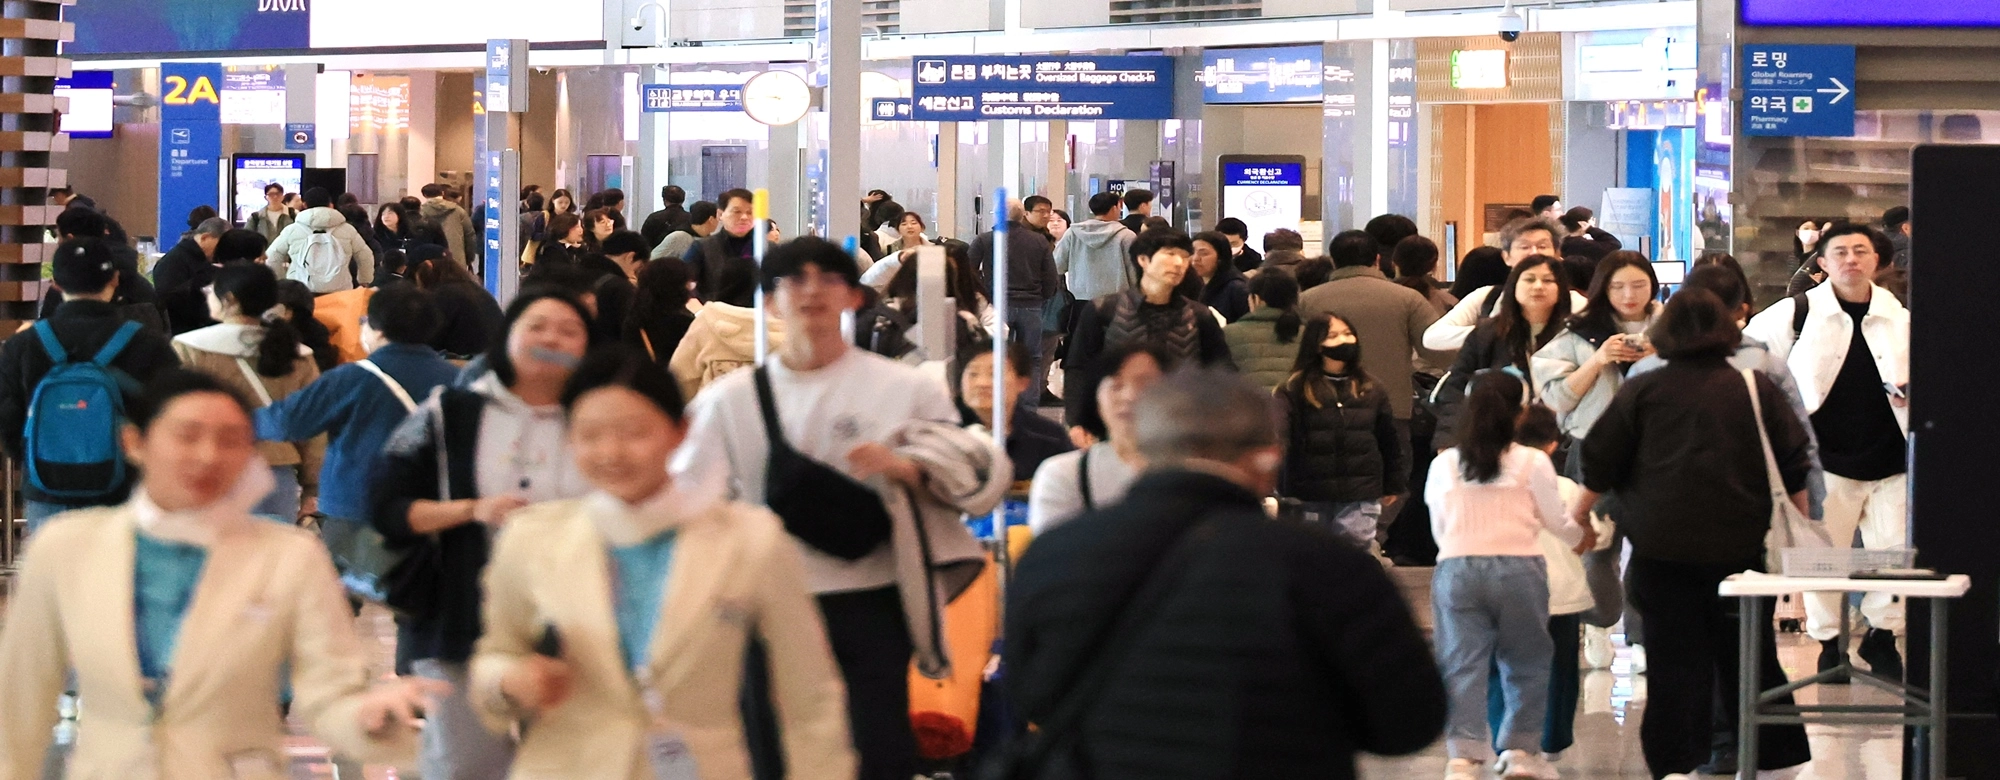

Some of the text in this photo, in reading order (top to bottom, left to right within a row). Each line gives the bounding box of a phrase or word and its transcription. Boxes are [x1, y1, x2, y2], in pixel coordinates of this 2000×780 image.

[1752, 52, 1787, 68] 로밍
[1035, 72, 1155, 84] Oversized Baggage Check-in
[1778, 71, 1813, 80] Roaming
[164, 75, 219, 105] 2A
[918, 96, 975, 111] 세관신고
[981, 105, 1103, 115] Customs Declaration
[1751, 96, 1787, 113] 약국
[1751, 115, 1789, 123] Pharmacy
